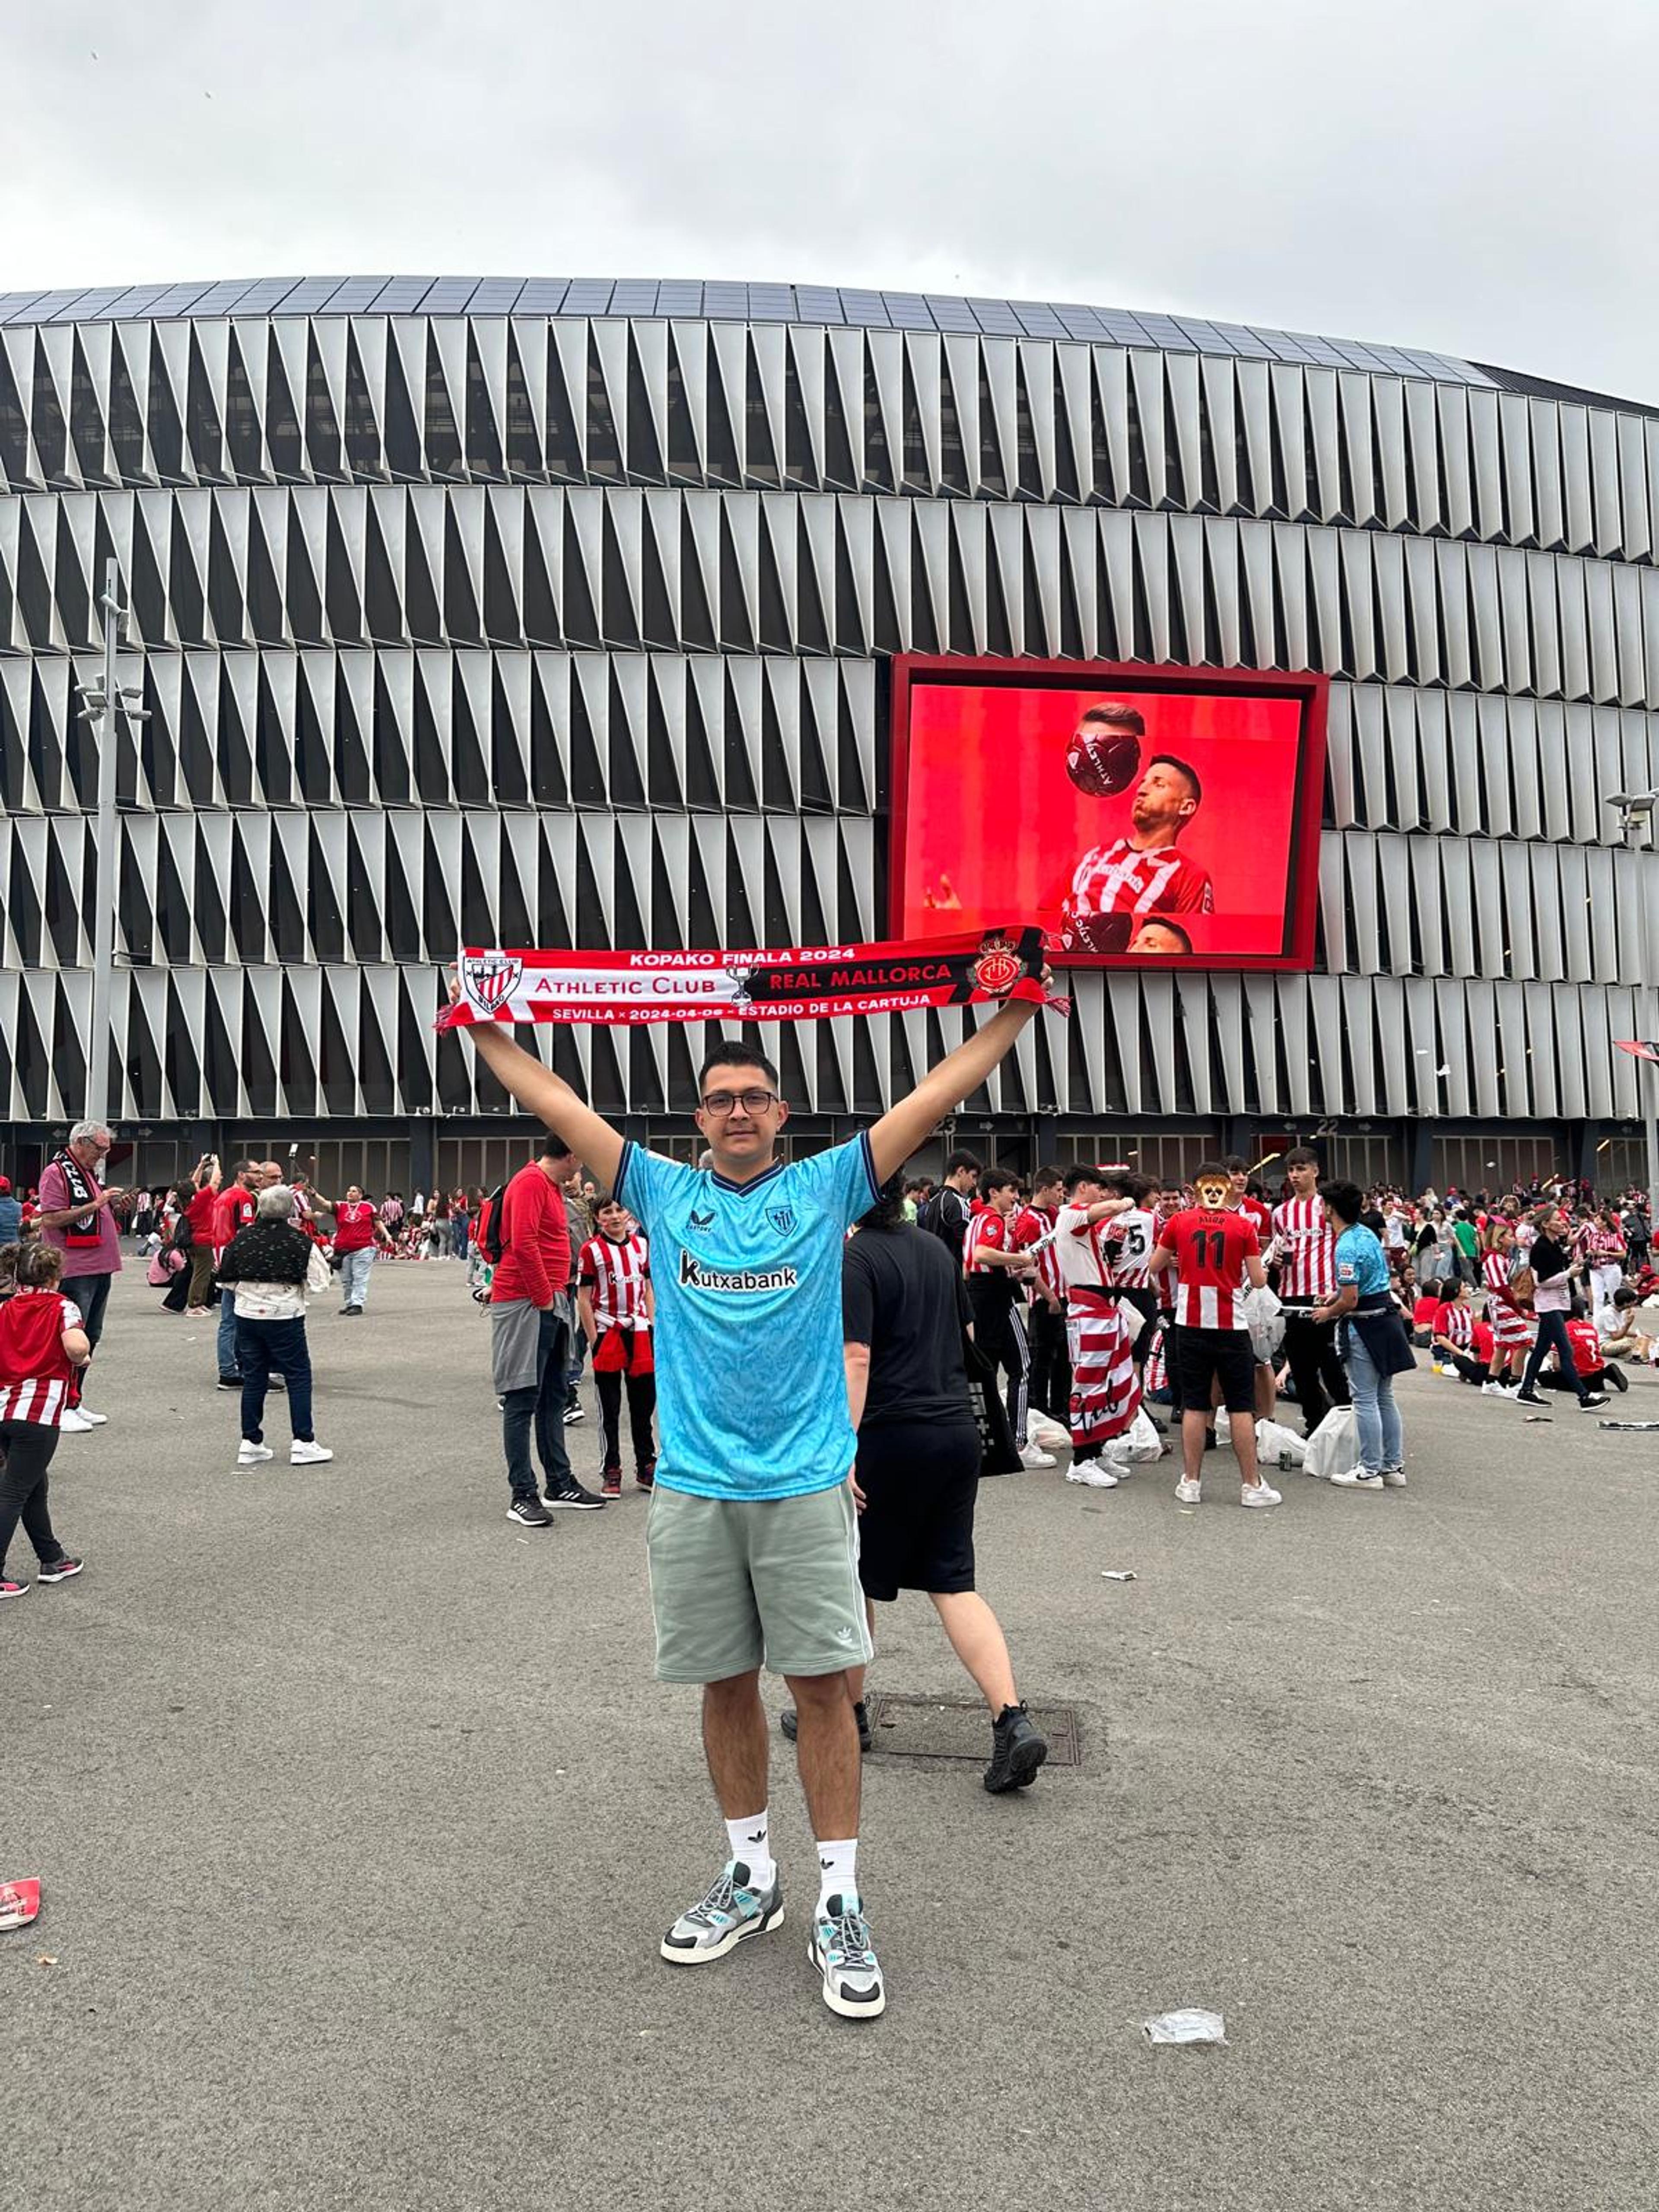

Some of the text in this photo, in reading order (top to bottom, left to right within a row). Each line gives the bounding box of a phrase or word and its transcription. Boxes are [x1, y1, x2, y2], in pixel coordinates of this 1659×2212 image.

[1084, 736, 1113, 785] ATHLETI
[630, 949, 855, 966] KOPAKO FINALA 2024
[769, 973, 821, 989] REAL
[830, 964, 951, 987] MALLORCA
[553, 1009, 615, 1020] SEVILLA
[738, 1004, 804, 1016] ESTADIO
[810, 1002, 829, 1014] DE
[833, 1002, 853, 1012] LA
[858, 994, 931, 1010] CARTUJA
[1317, 1119, 1339, 1135] 22
[1192, 1230, 1225, 1269] 11
[681, 1250, 796, 1290] Kutxabank
